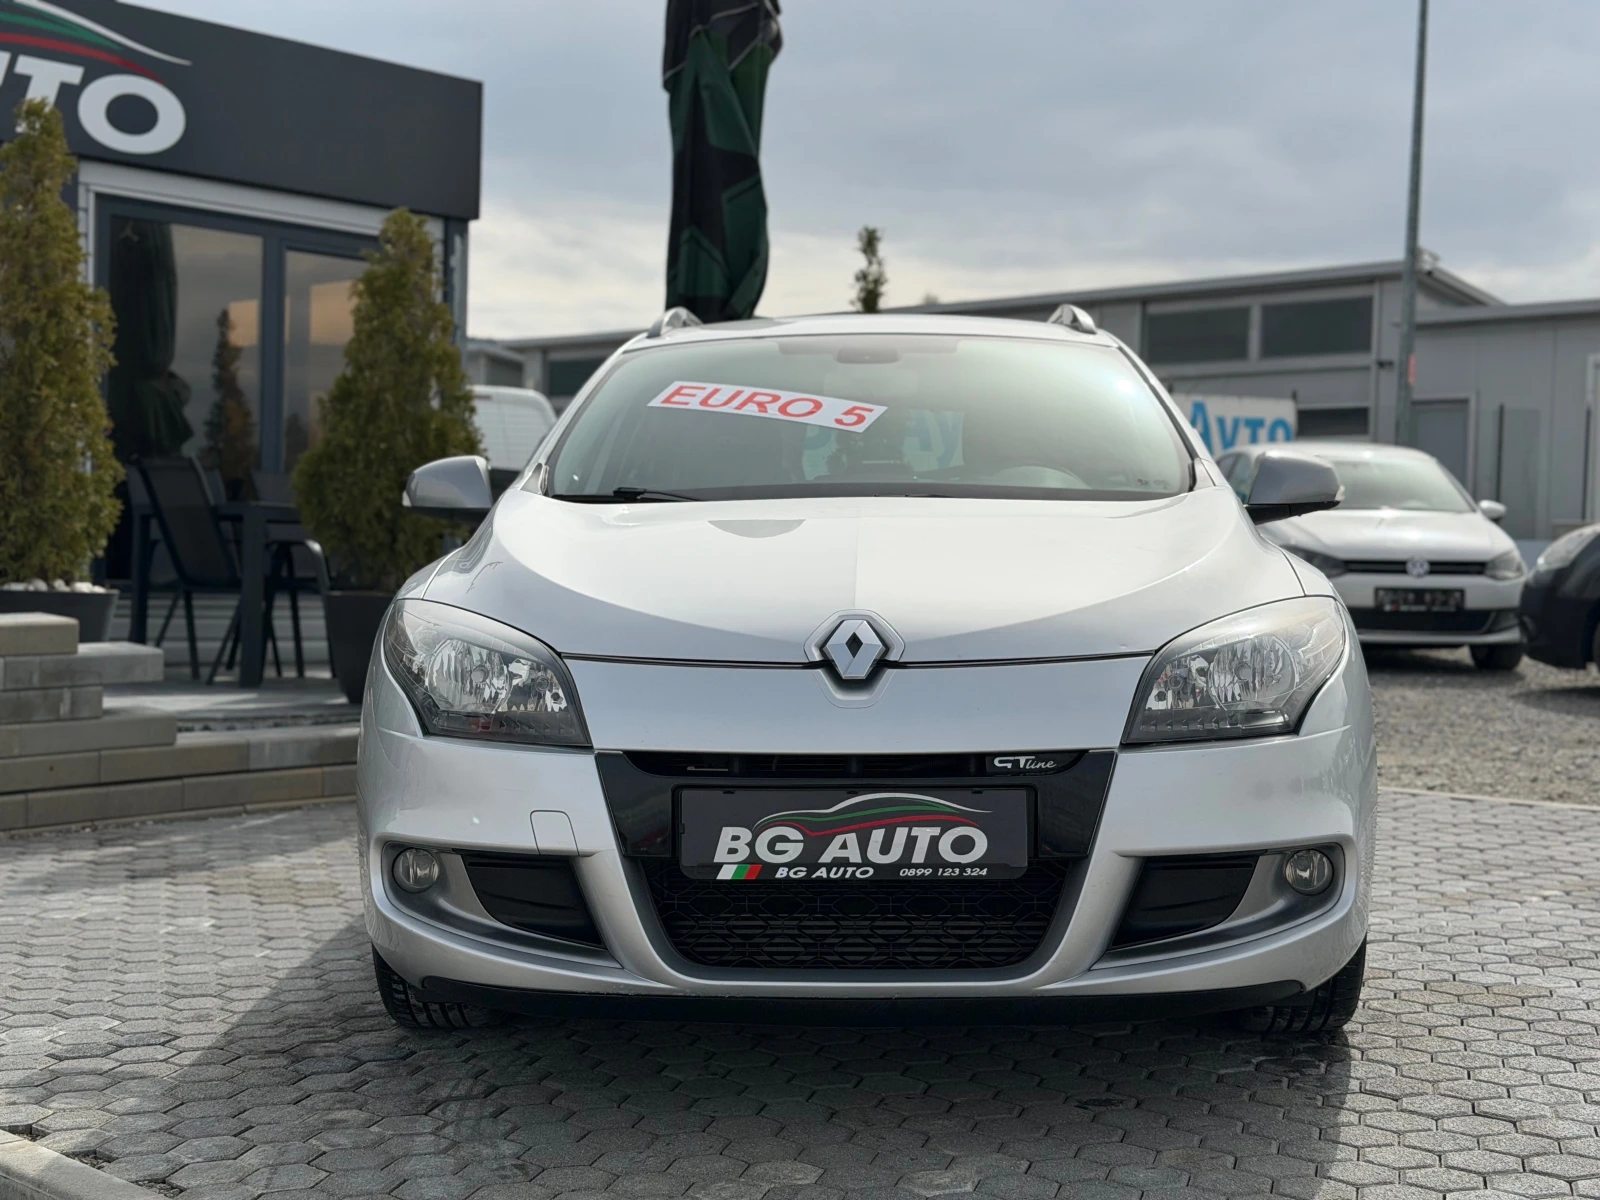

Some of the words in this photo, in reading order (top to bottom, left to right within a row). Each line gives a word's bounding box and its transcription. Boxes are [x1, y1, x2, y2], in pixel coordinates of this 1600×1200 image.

[0, 50, 186, 155] TO
[660, 385, 824, 418] EURO
[834, 405, 874, 428] 5
[713, 826, 805, 864] BG
[817, 826, 988, 864] AUTO
[774, 867, 807, 879] BG
[811, 867, 875, 879] AUTO
[899, 868, 933, 877] 0899
[937, 867, 961, 877] 123
[962, 867, 988, 877] 324
